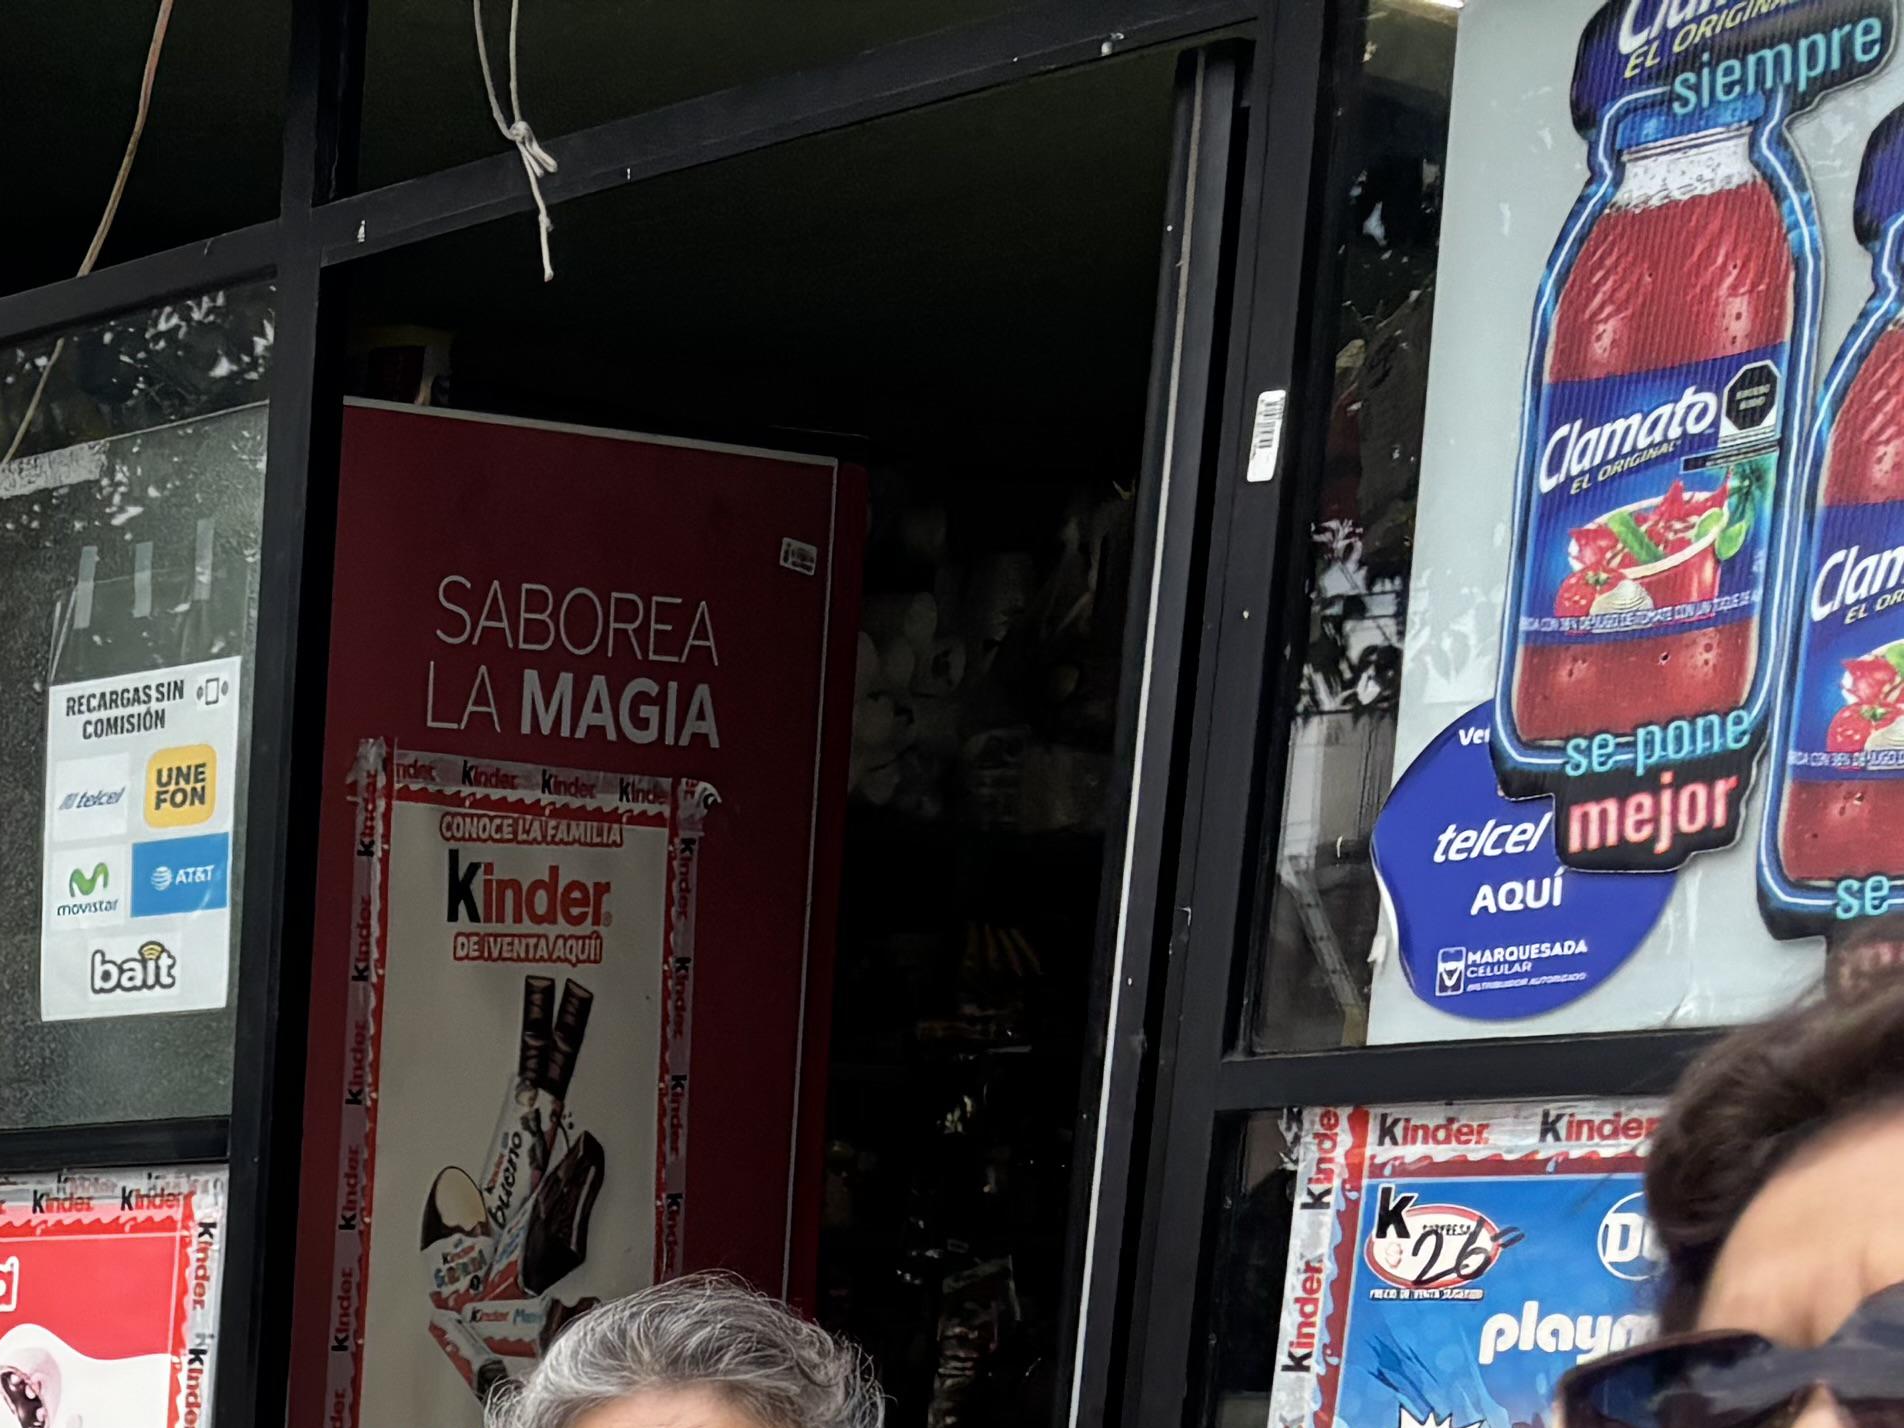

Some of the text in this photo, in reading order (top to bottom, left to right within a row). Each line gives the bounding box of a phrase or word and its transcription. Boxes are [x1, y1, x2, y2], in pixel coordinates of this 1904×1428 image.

[1624, 46, 1661, 79] EL
[1672, 16, 1883, 115] siempre
[1539, 385, 1718, 494] Clamato
[1570, 475, 1593, 495] EL
[1598, 443, 1678, 483] ORIGINAL
[1810, 544, 1904, 622] Clam
[435, 574, 720, 667] SABOREA
[1845, 603, 1869, 624] EL
[65, 680, 185, 717] RECARGAS SIN
[426, 660, 720, 748] LA MAGIA
[82, 705, 166, 740] COMISIÓN
[1565, 708, 1752, 777] se pone
[154, 761, 208, 789] UNE
[154, 783, 208, 812] FON
[75, 787, 124, 812] telcel
[1569, 771, 1739, 855] mejor
[441, 814, 621, 846] CONOCE LA FAMILIA
[1433, 812, 1553, 863] telcel
[174, 862, 216, 885] AT&T
[447, 848, 610, 926] Kinder
[1470, 866, 1568, 916] AQUÍ
[56, 897, 119, 918] movistar
[1835, 875, 1891, 920] se
[91, 944, 178, 994] bait
[455, 934, 481, 959] DE
[1467, 939, 1588, 964] MARQUESADA
[1466, 961, 1533, 979] CELULAR
[1378, 1113, 1490, 1147] Kinder
[1300, 1107, 1340, 1210] Kinde
[1281, 1250, 1327, 1374] Kinder
